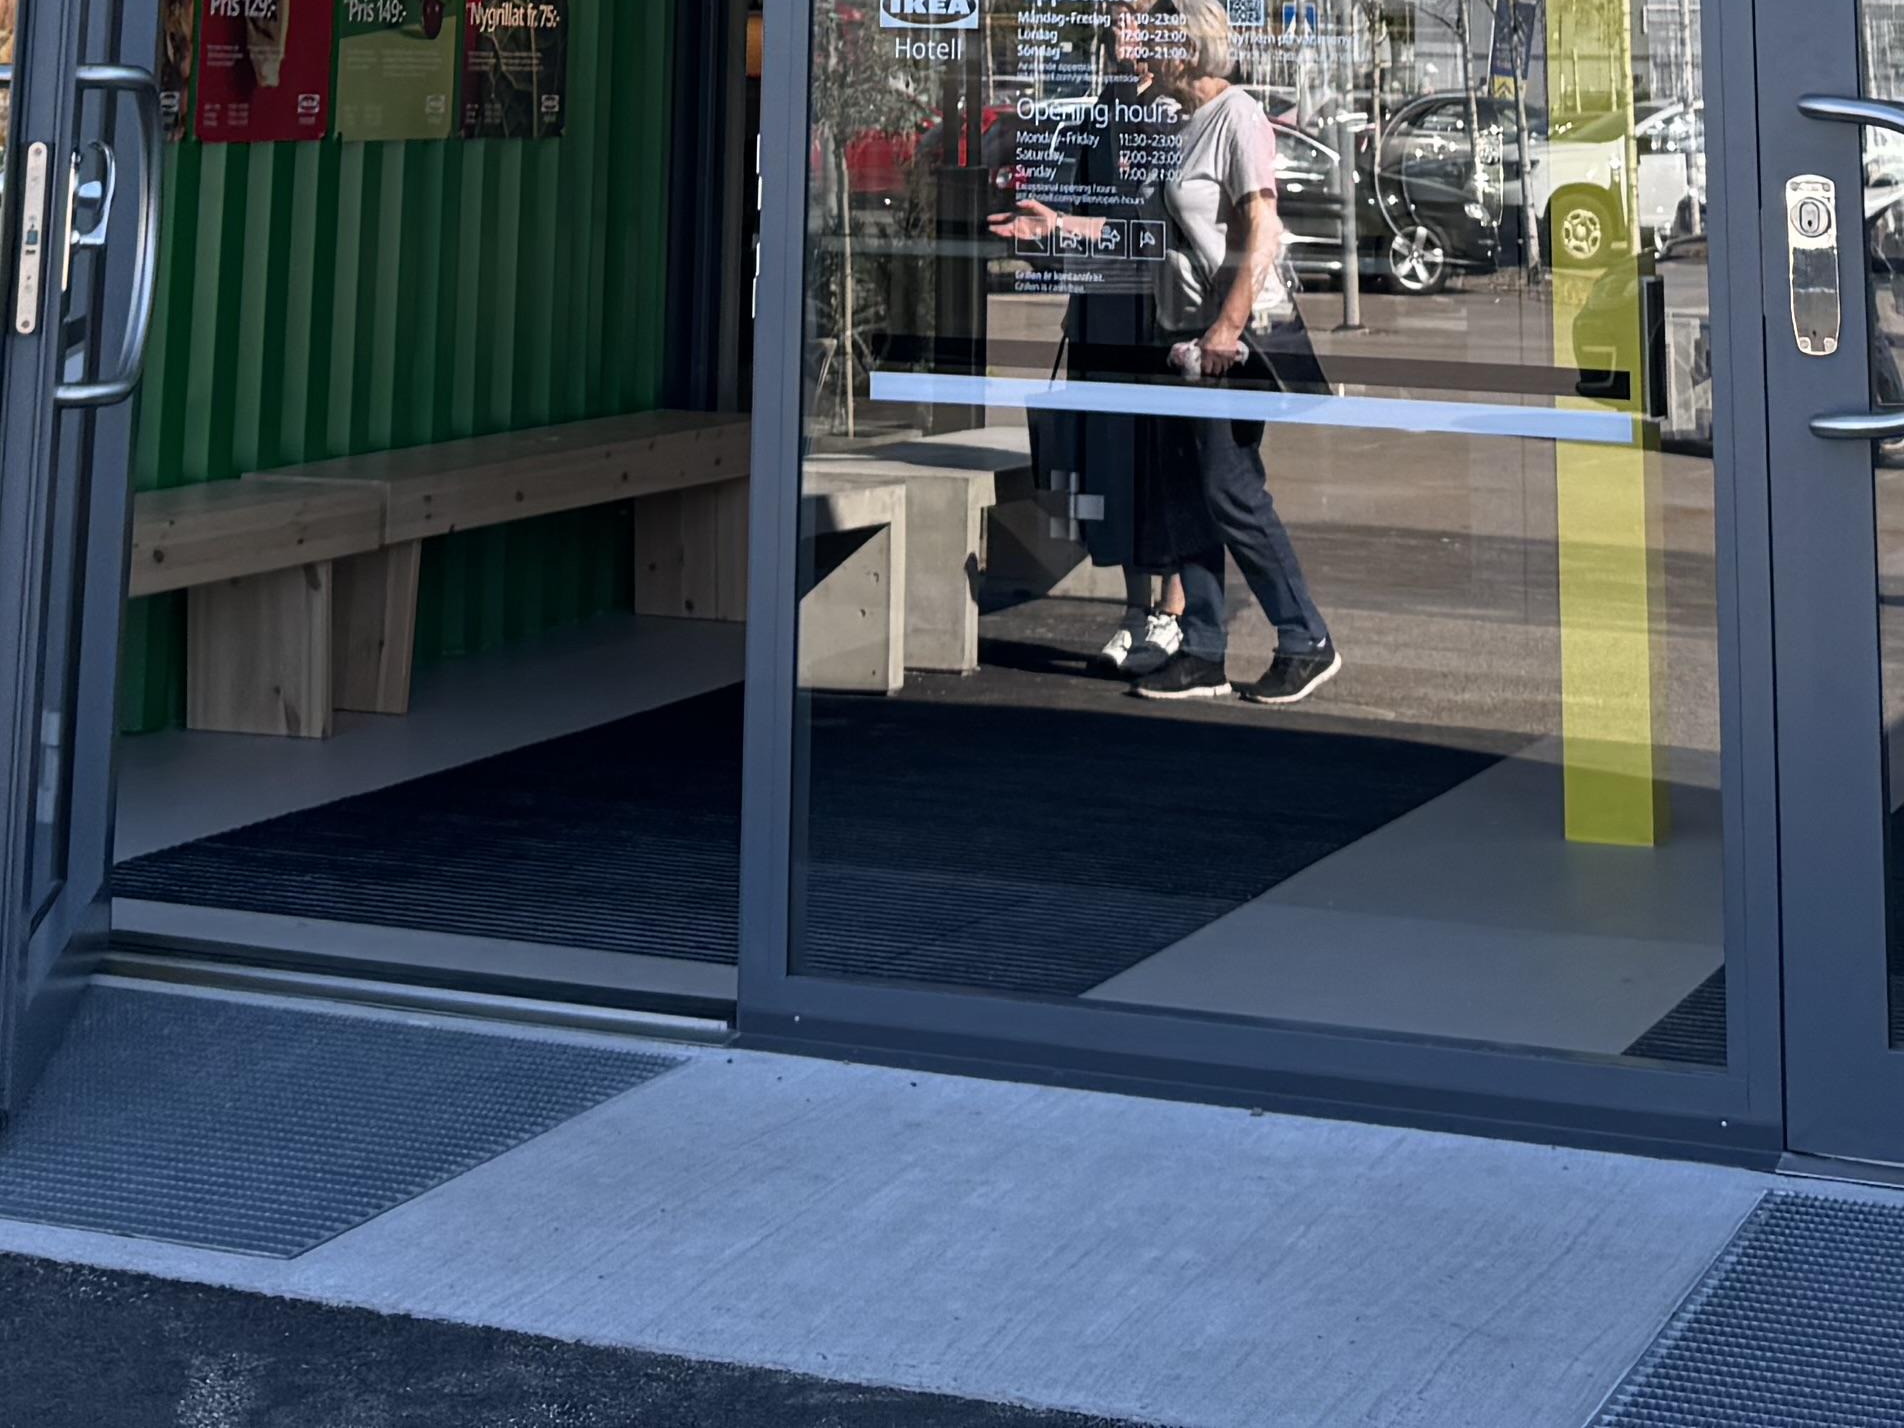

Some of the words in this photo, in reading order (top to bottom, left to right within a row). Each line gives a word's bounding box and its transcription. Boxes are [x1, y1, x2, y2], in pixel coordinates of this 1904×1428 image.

[895, 37, 961, 60] Hotell
[1016, 97, 1109, 128] Opening
[1115, 99, 1178, 123] hours
[1016, 149, 1064, 165] Saturday
[1016, 164, 1057, 180] Sunday
